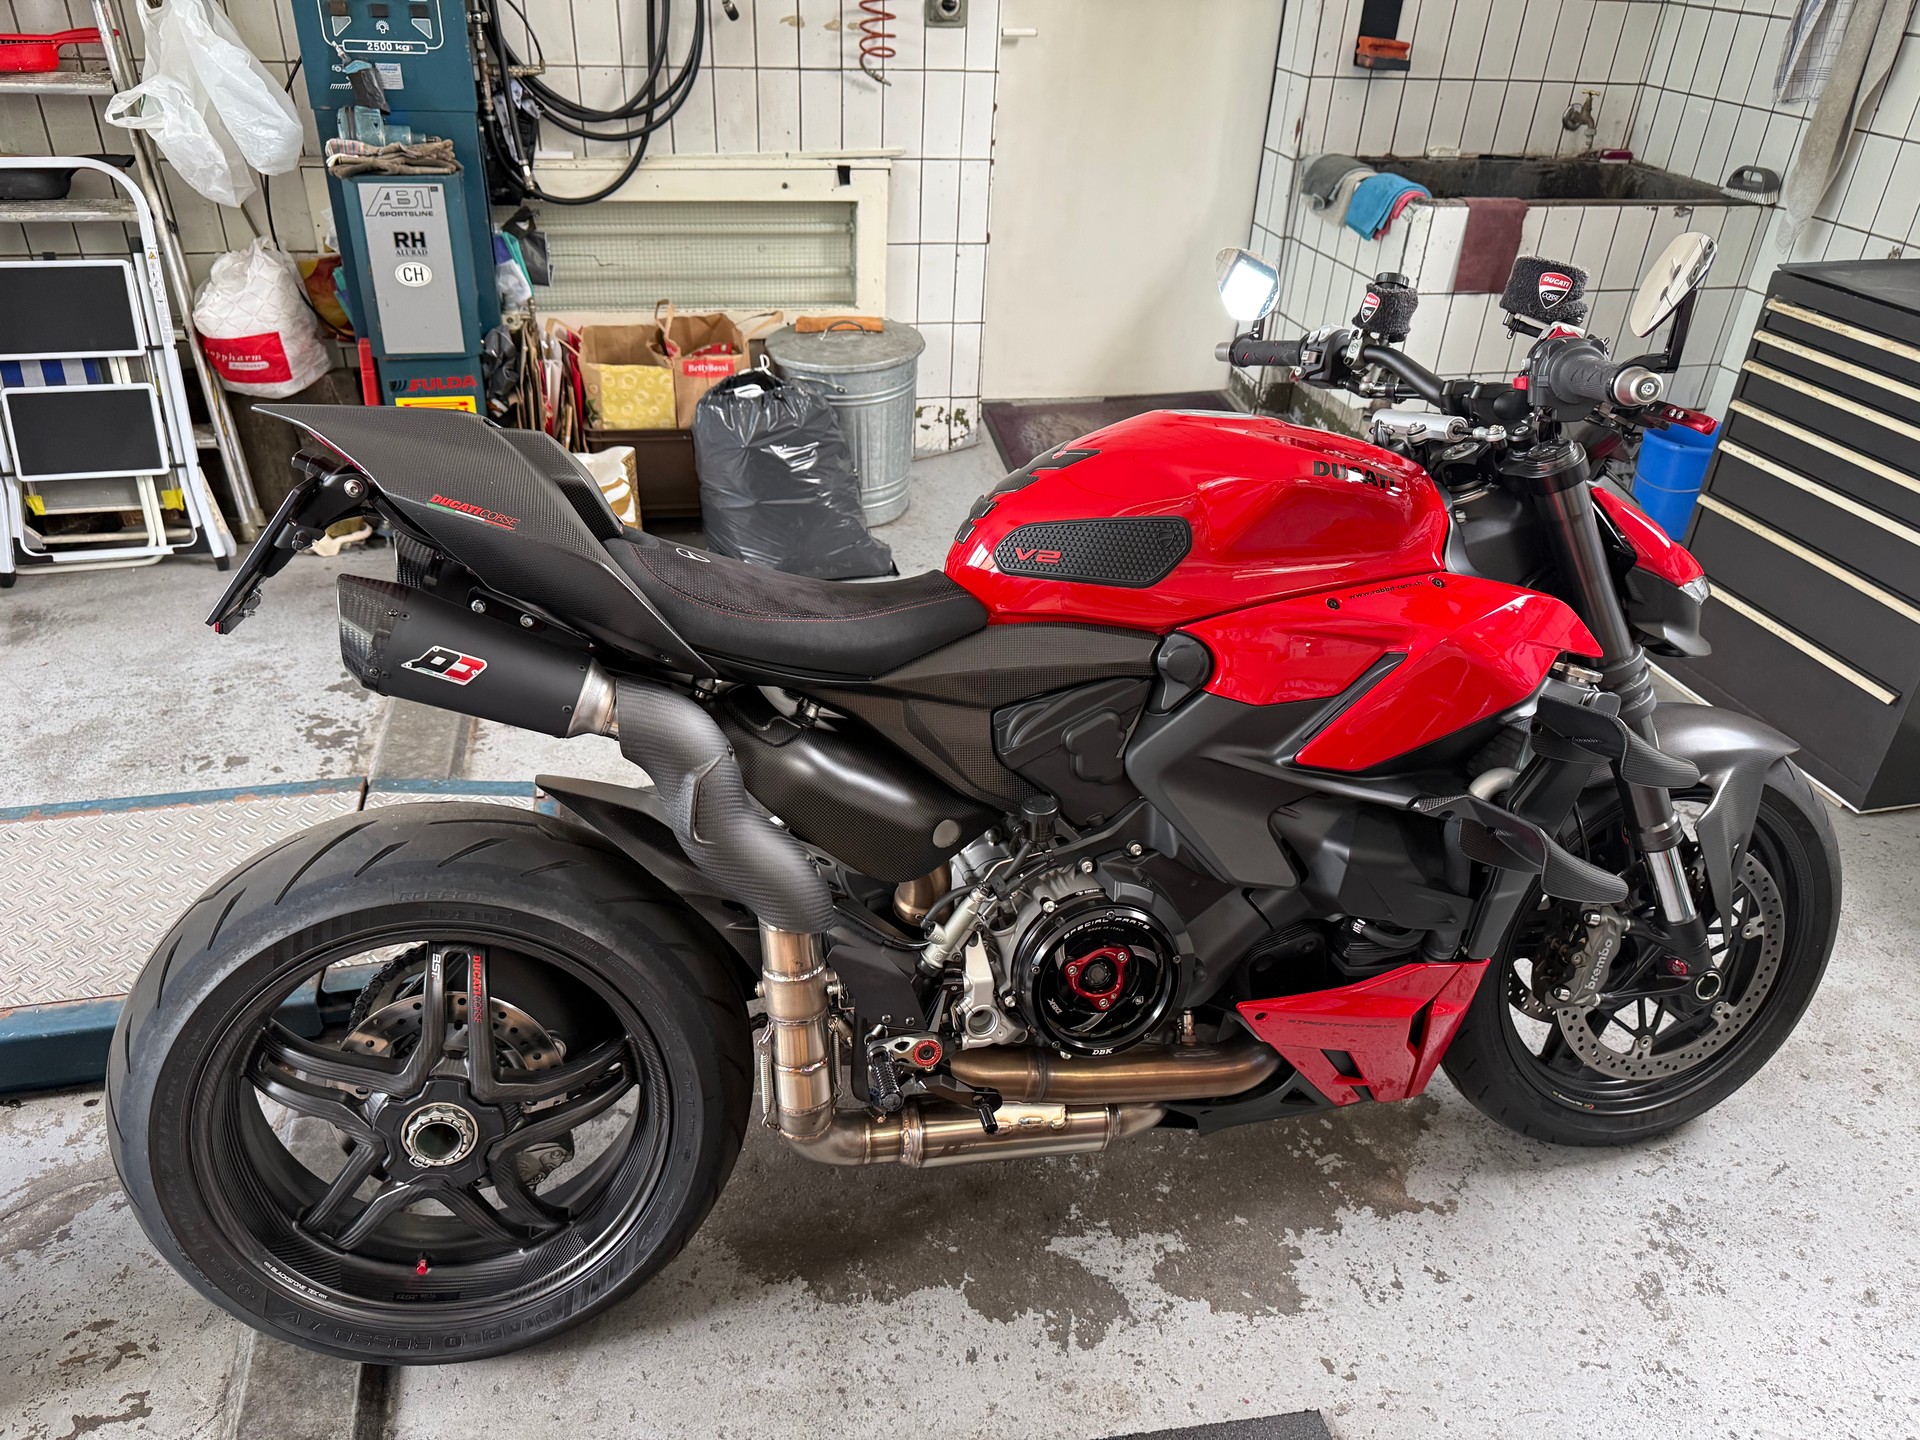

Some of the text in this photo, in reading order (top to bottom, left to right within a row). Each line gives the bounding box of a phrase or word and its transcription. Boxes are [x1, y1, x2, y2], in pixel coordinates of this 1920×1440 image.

[366, 42, 411, 51] 2500 kg
[366, 186, 433, 216] ABT
[394, 231, 426, 248] RH
[403, 267, 425, 282] CH
[1543, 275, 1571, 288] DUCATI
[407, 375, 478, 392] FULDA
[1015, 548, 1062, 564] V2
[1063, 917, 1150, 939] SPECIAL PARTS
[431, 953, 441, 980] BST
[1584, 939, 1613, 990] brembo
[270, 1266, 319, 1296] BLACKSTONE TEK
